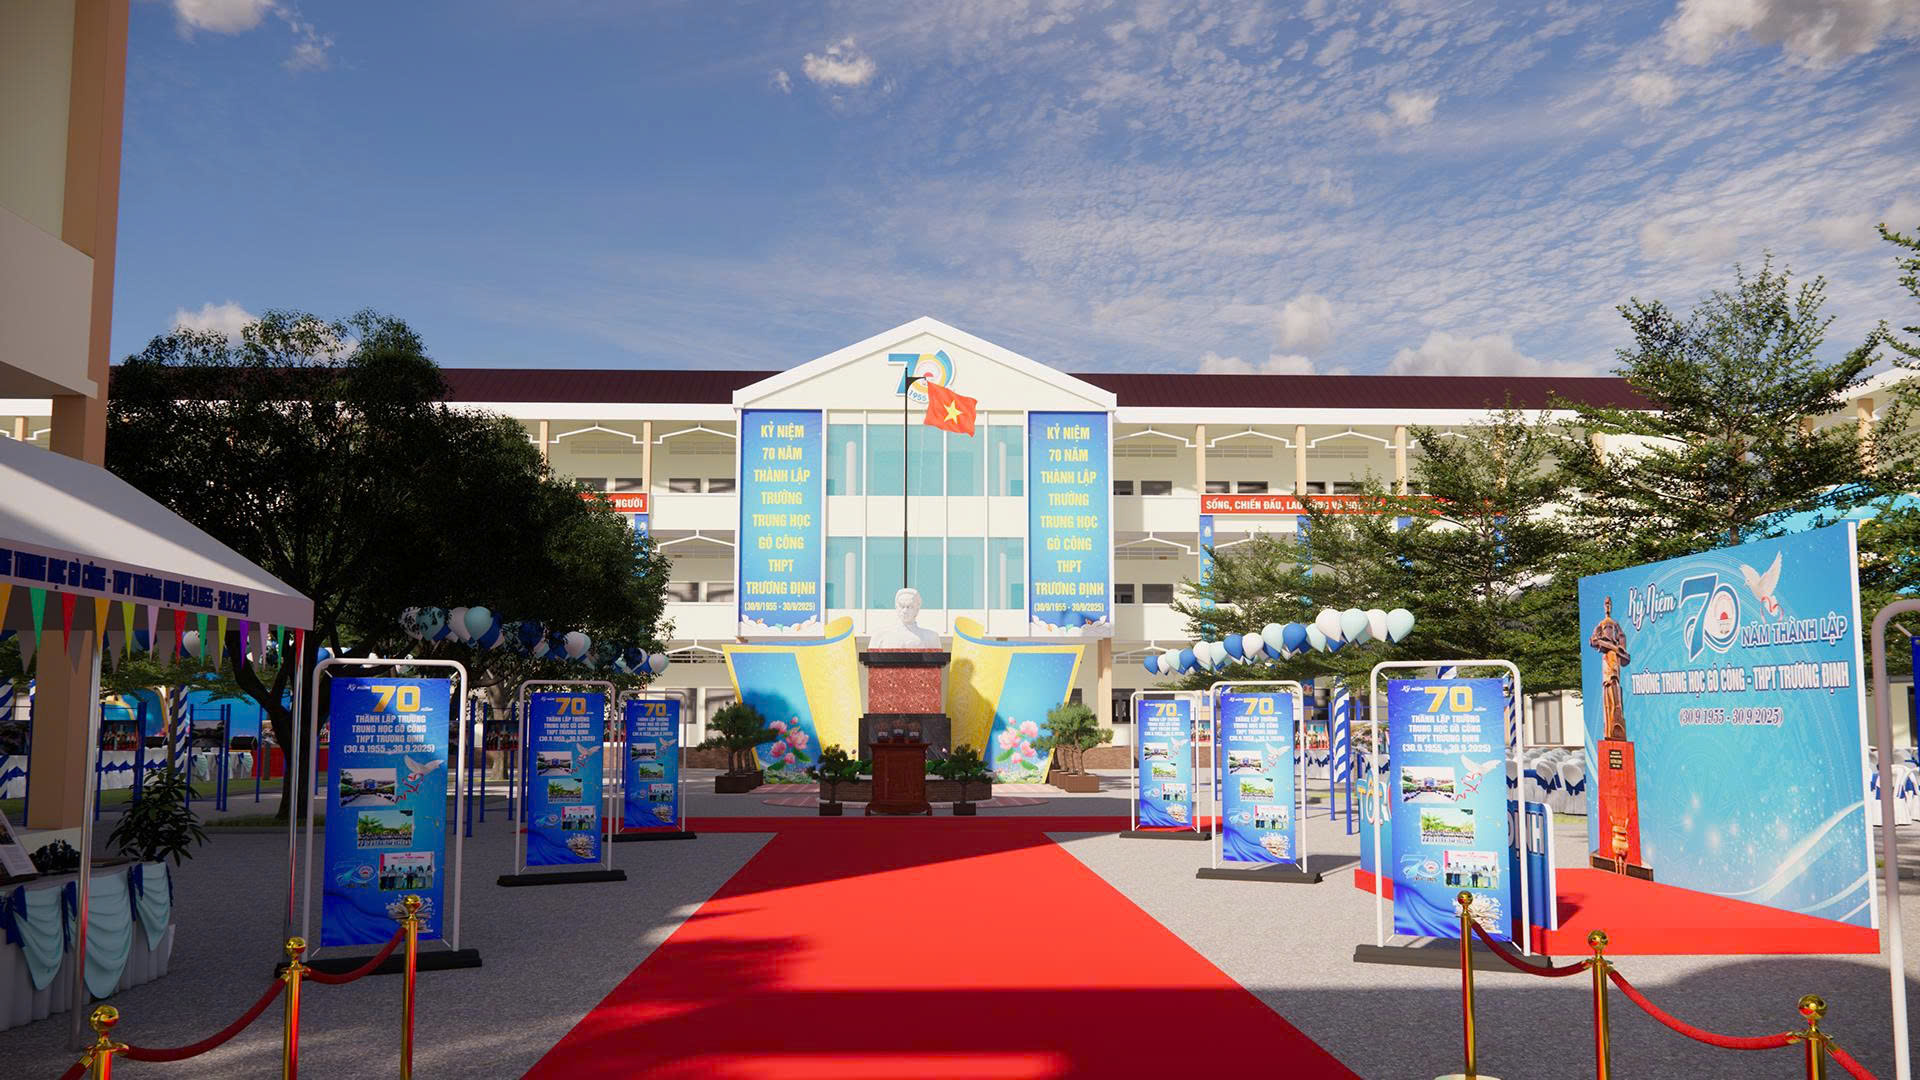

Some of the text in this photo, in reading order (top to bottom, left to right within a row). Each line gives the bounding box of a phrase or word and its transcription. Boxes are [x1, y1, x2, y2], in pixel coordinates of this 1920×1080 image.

[908, 390, 927, 401] 1955
[761, 421, 804, 440] KỶ NIỆM
[1063, 424, 1090, 442] NIỆM
[762, 445, 802, 460] 70 NĂM
[1049, 446, 1089, 462] 70 NĂM
[753, 466, 811, 485] THÀNH LẬP
[1041, 468, 1097, 486] THÀNH LẬP
[615, 497, 643, 508] NGƯỜI
[761, 489, 803, 504] TRƯỜNG
[1048, 490, 1089, 506] TRƯỜNG
[1206, 498, 1232, 511] SỐNG,
[1234, 498, 1261, 510] CHIẾN
[1263, 498, 1284, 511] ĐẤU,
[1286, 501, 1303, 510] LAO
[752, 514, 811, 529] TRUNG HỌC
[1040, 516, 1098, 531] TRUNG HỌC
[758, 533, 804, 549] GÒ CÔNG
[1047, 535, 1092, 551] GÒ CÔNG
[768, 559, 794, 572] THPT
[1056, 560, 1082, 573] THPT
[746, 580, 816, 597] TRƯƠNG ĐỊNH
[1035, 581, 1104, 598] TRƯƠNG ĐỊNH
[1628, 583, 1676, 631] Kỷ Niệm
[1679, 572, 1740, 662] 70
[1741, 621, 1770, 648] NĂM
[1772, 616, 1818, 646] THÀNH
[1820, 611, 1848, 646] LẬP
[1632, 667, 1661, 695] TRƯỜNG
[1661, 671, 1688, 694] TRUNG
[1688, 670, 1706, 698] HỌC
[1707, 663, 1719, 693] GÒ
[1720, 663, 1746, 692] CÔNG
[1752, 665, 1777, 691] THPT
[1778, 661, 1820, 690] TRƯƠNG
[1821, 661, 1850, 694] ĐỊNH
[371, 686, 420, 712] 70
[556, 698, 586, 715] 70
[1243, 698, 1273, 715] 70
[1424, 686, 1473, 712] 70
[644, 703, 666, 716] 70
[1155, 703, 1177, 716] 70
